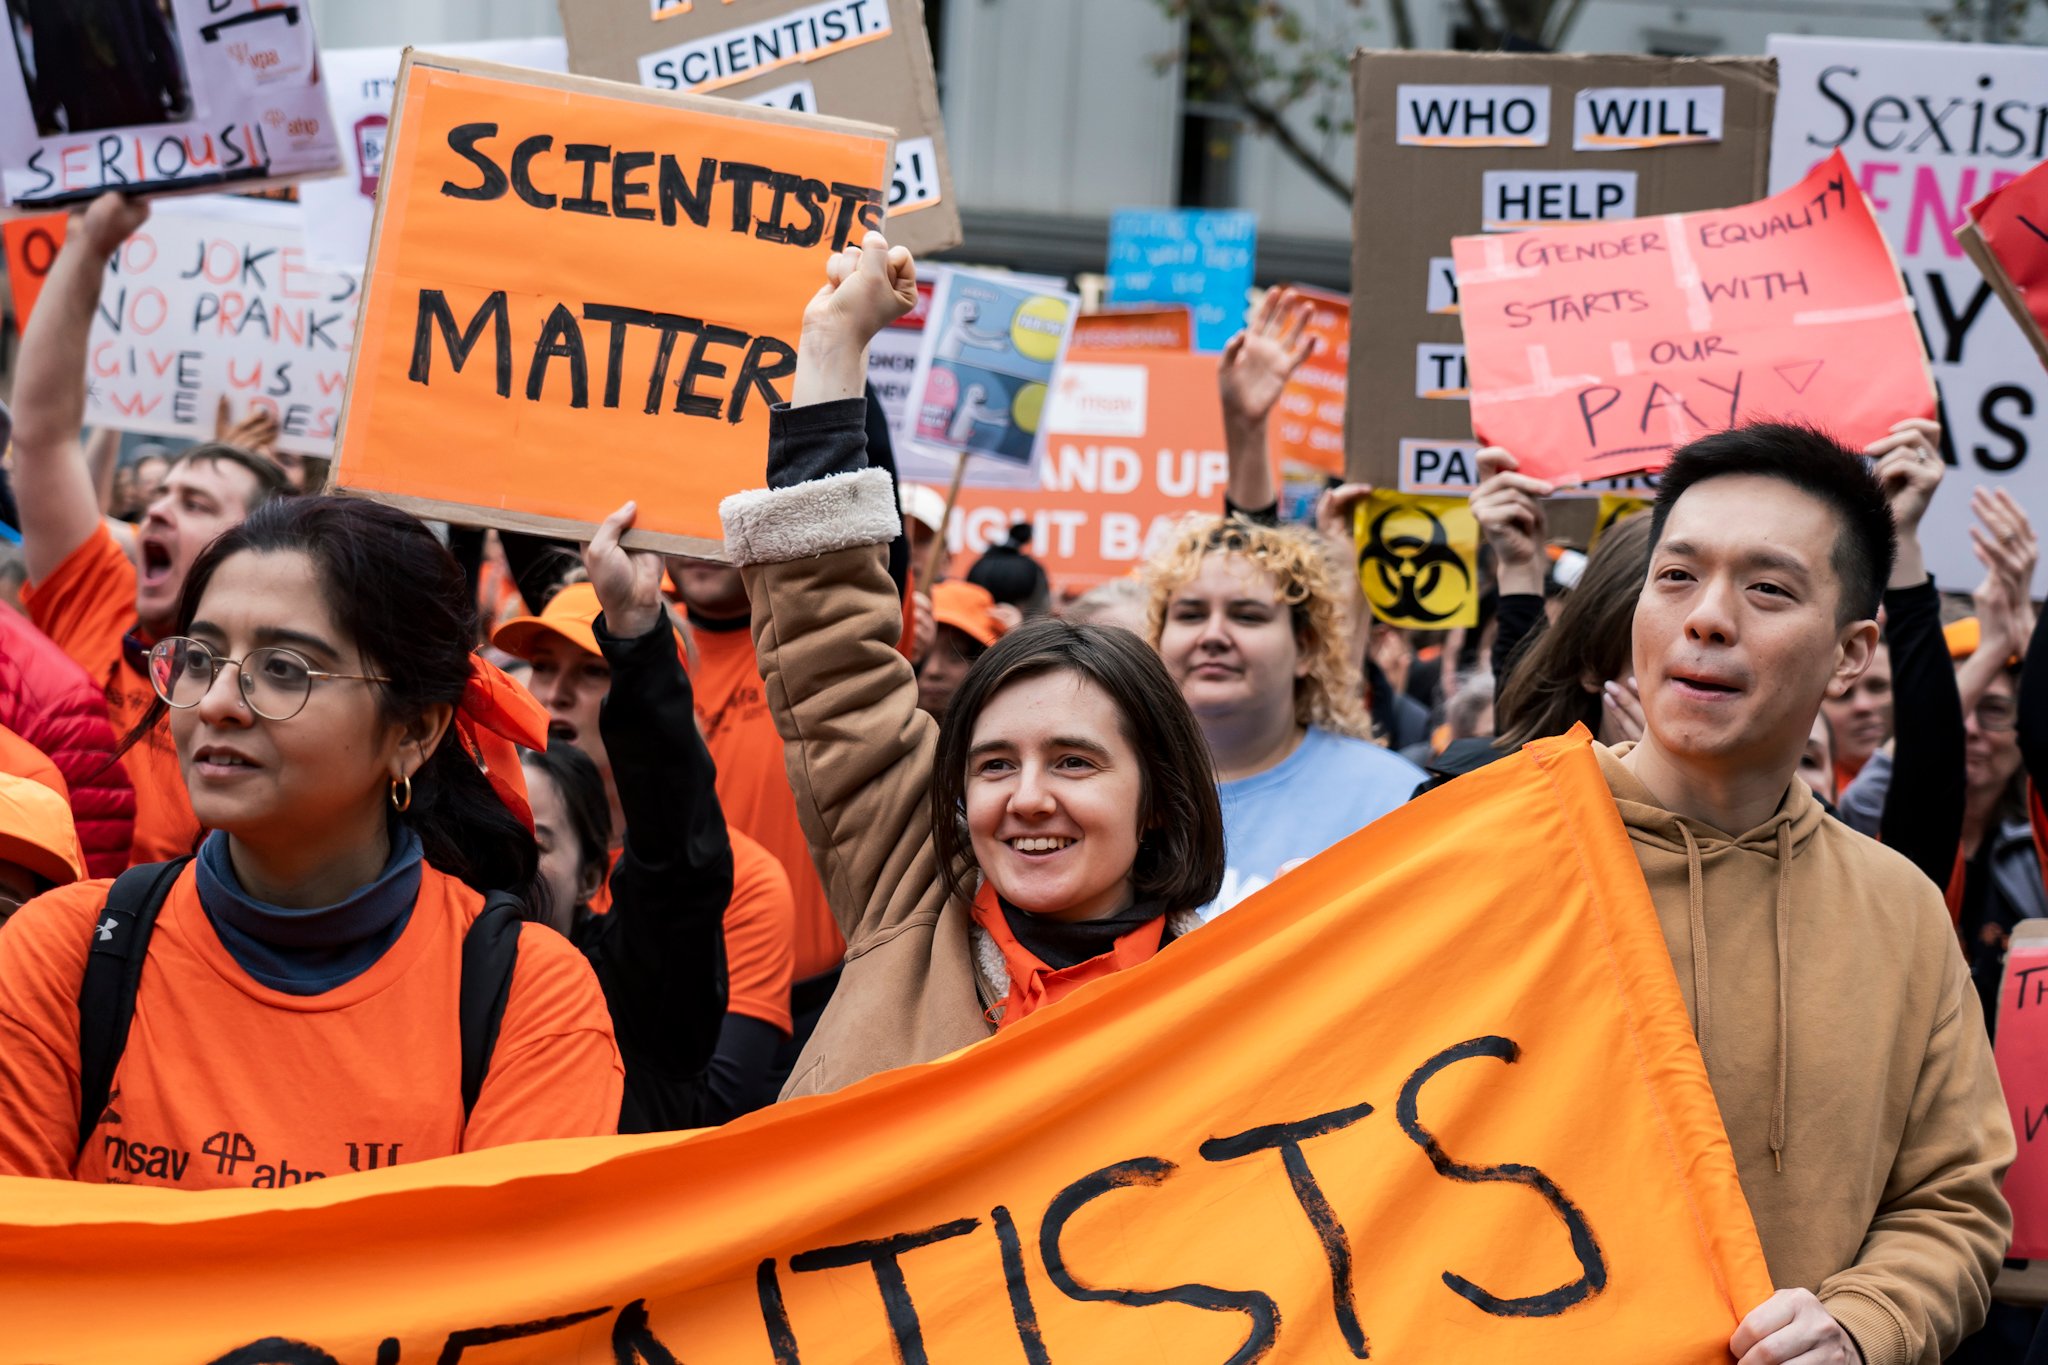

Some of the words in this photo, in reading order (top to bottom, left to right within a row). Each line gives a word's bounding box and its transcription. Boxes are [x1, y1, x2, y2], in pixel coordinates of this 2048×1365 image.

[1411, 98, 1536, 136] WHO
[1589, 98, 1710, 137] WILL
[1806, 65, 2048, 161] Sexis
[440, 122, 884, 254] SCIENTISTS
[1499, 183, 1624, 221] HELP
[1515, 232, 1667, 269] GENDER
[1699, 171, 1848, 248] EQUALITY
[193, 291, 360, 349] PRANK
[1504, 289, 1650, 329] STARTS
[1702, 270, 1810, 304] WITH
[93, 341, 203, 389] GIVE
[228, 358, 292, 396] US
[408, 289, 799, 424] MATTER
[1429, 354, 1468, 390] T
[1649, 335, 1739, 365] OUR
[110, 391, 197, 424] WE
[1577, 370, 1744, 447] PAY
[1156, 449, 1230, 499] UP
